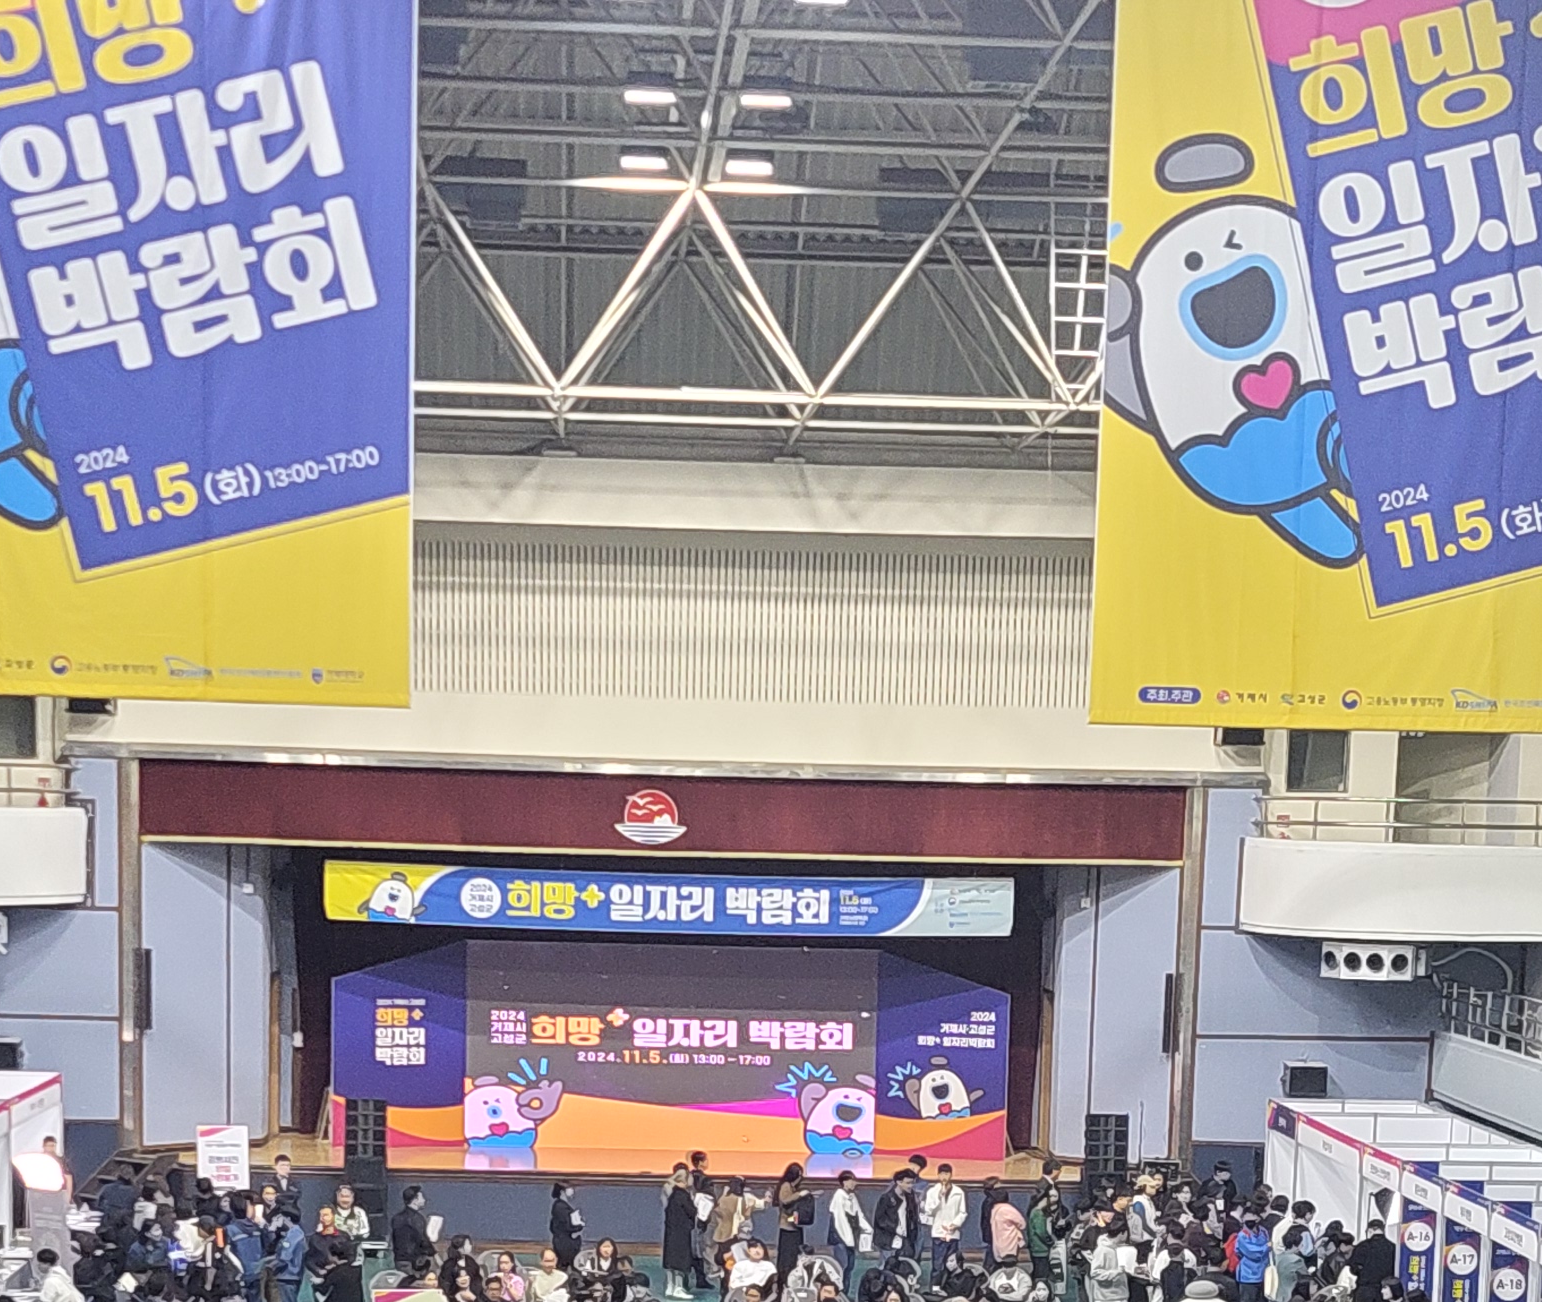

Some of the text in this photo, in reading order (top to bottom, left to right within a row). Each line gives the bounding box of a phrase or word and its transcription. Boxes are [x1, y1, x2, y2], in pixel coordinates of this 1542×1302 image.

[28, 196, 378, 371] 박람회
[74, 445, 130, 473] 2024
[83, 461, 199, 533] 11.5
[204, 462, 262, 505] (화)
[1378, 483, 1429, 512] 2024
[1384, 498, 1494, 568] 11.5
[609, 883, 715, 922] 일자리
[725, 887, 831, 925] 박람회
[491, 1010, 526, 1021] 2024
[970, 1011, 997, 1022] 2024
[490, 1022, 527, 1033] 거제시
[633, 1017, 739, 1049] 일자리
[749, 1020, 854, 1051] 박람회
[375, 1028, 426, 1046] 일자리
[490, 1033, 527, 1045] 고성군
[375, 1047, 426, 1066] 박람회
[1405, 1230, 1431, 1243] A-16
[1449, 1253, 1476, 1266] A-17
[1496, 1278, 1523, 1291] A-18
